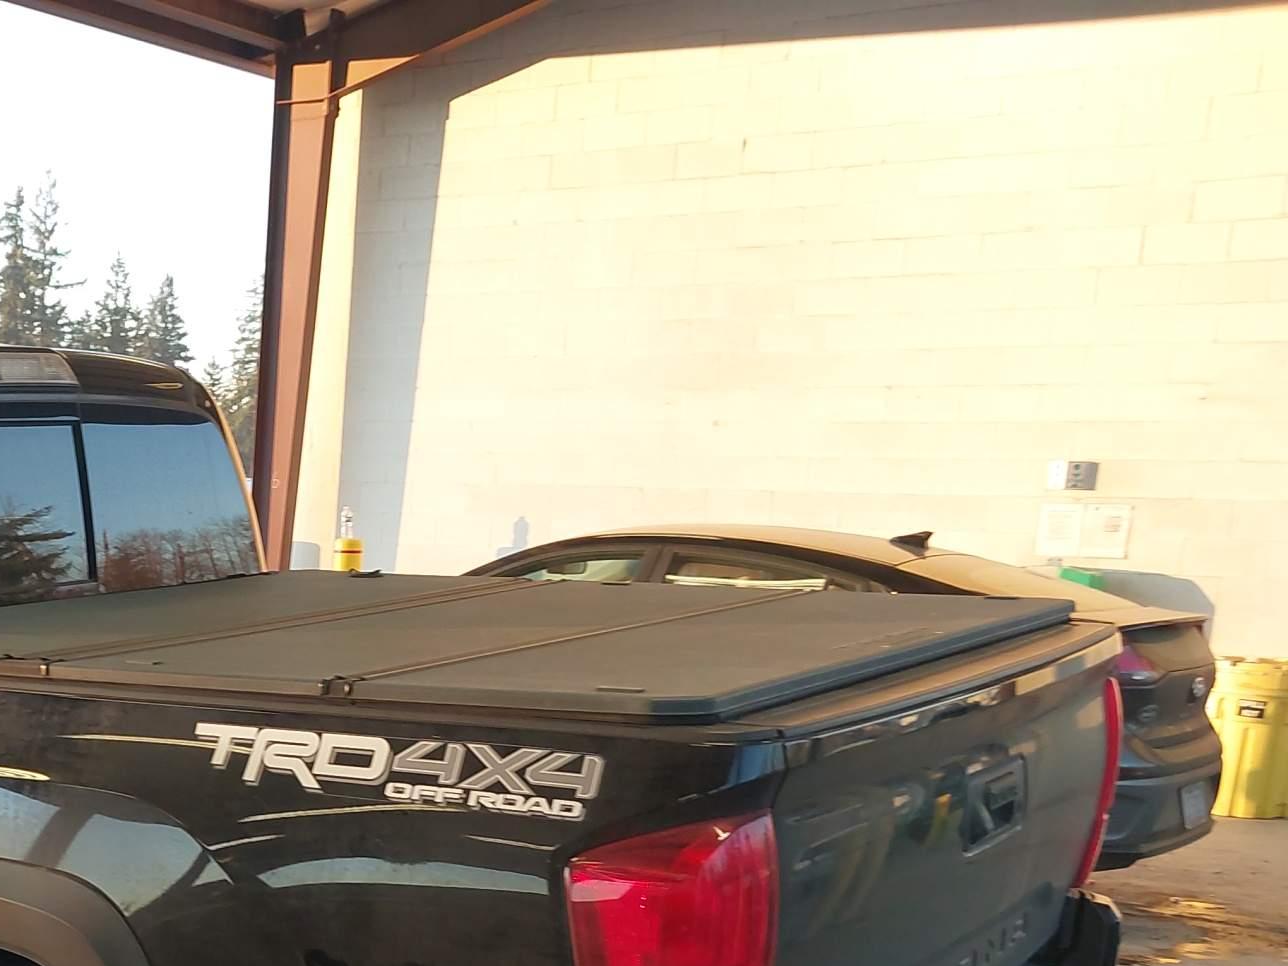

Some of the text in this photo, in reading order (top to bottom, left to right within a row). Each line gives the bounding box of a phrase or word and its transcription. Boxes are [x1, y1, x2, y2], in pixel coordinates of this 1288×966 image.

[194, 722, 393, 794] TRD
[384, 782, 586, 821] OFF ROAD
